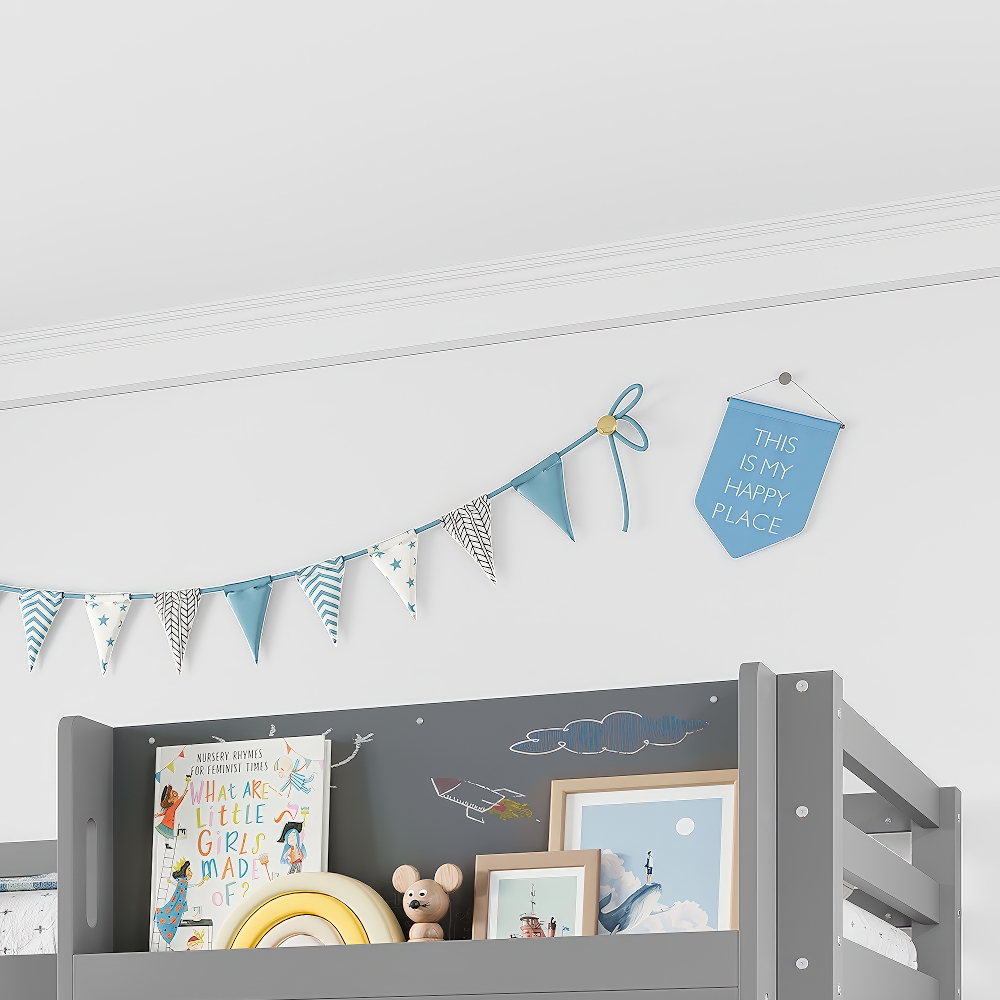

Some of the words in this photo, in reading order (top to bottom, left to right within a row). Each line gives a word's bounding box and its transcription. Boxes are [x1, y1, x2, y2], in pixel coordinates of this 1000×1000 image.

[754, 427, 799, 454] THIS
[739, 453, 758, 472] IS
[759, 458, 794, 480] MY
[723, 477, 791, 507] HAPPY
[711, 502, 783, 535] PLACE
[190, 765, 205, 776] FOR
[207, 762, 243, 775] FEMINIST
[245, 761, 269, 772] TIMES
[196, 751, 230, 763] NURSERY
[232, 748, 263, 760] RHYMES
[242, 779, 270, 802] ARE
